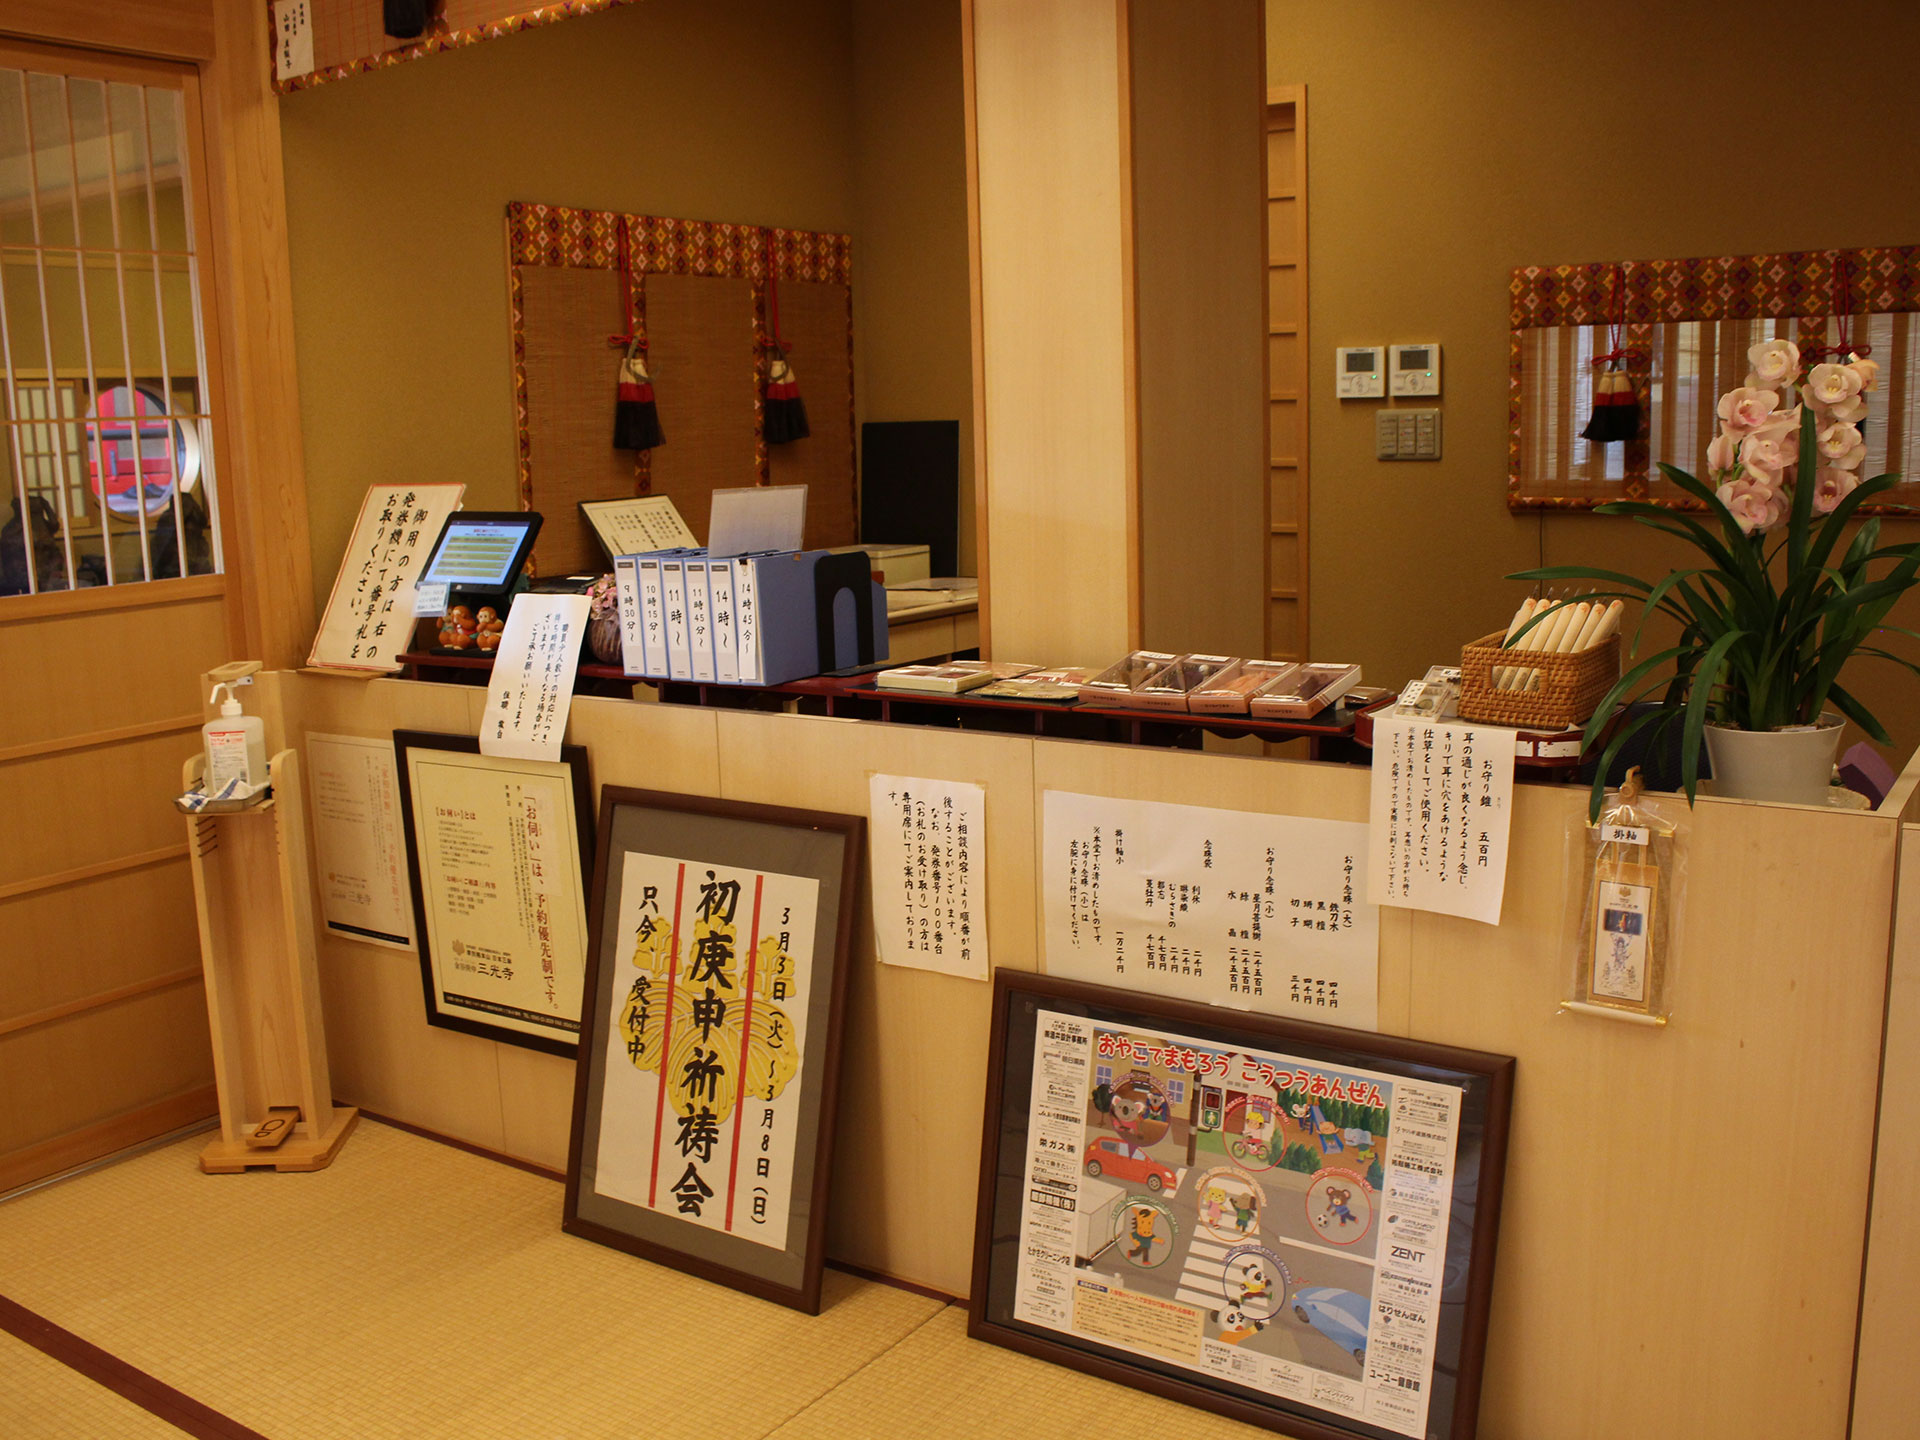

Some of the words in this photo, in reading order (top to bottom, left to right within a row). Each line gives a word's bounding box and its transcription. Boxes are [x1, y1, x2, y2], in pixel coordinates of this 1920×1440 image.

[351, 493, 399, 616] お取りください。
[351, 492, 416, 658] 発券機にて番号札を
[366, 509, 428, 658] 御用の方は右の
[888, 791, 898, 807] す。
[1419, 728, 1434, 872] 仕草をしてご使用ください。
[1480, 759, 1493, 808] お守り錐
[1478, 831, 1490, 867] 五百円
[1613, 828, 1637, 841] 掛軸
[902, 792, 915, 950] 専用席にてご案内しておりま
[943, 796, 957, 936] 後することがございます。
[957, 812, 970, 960] ご相談内容により順番が前
[1116, 931, 1124, 973] 一万二千円
[1146, 934, 1155, 969] 千七百円
[1158, 936, 1167, 971] 千七百円
[1170, 947, 1178, 973] 二千円
[1182, 949, 1190, 975] 二千円
[1193, 950, 1202, 977] 二千円
[1229, 947, 1238, 992] 二千五百円
[478, 963, 514, 980] 三光寺
[1241, 949, 1250, 994] 二千五百円
[1253, 951, 1262, 996] 二千五百円
[1290, 975, 1299, 1002] 三千円
[1303, 978, 1312, 1004] 四千円
[1316, 980, 1325, 1006] 四千円
[1329, 981, 1338, 1008] 四千円
[670, 870, 741, 1218] 初庚申祈祷会
[1098, 1033, 1231, 1078] おやこでまもろう
[1242, 1061, 1386, 1110] こうつうあんぜん
[1391, 1245, 1426, 1263] ZENT
[1378, 1304, 1426, 1324] はりせんぼん
